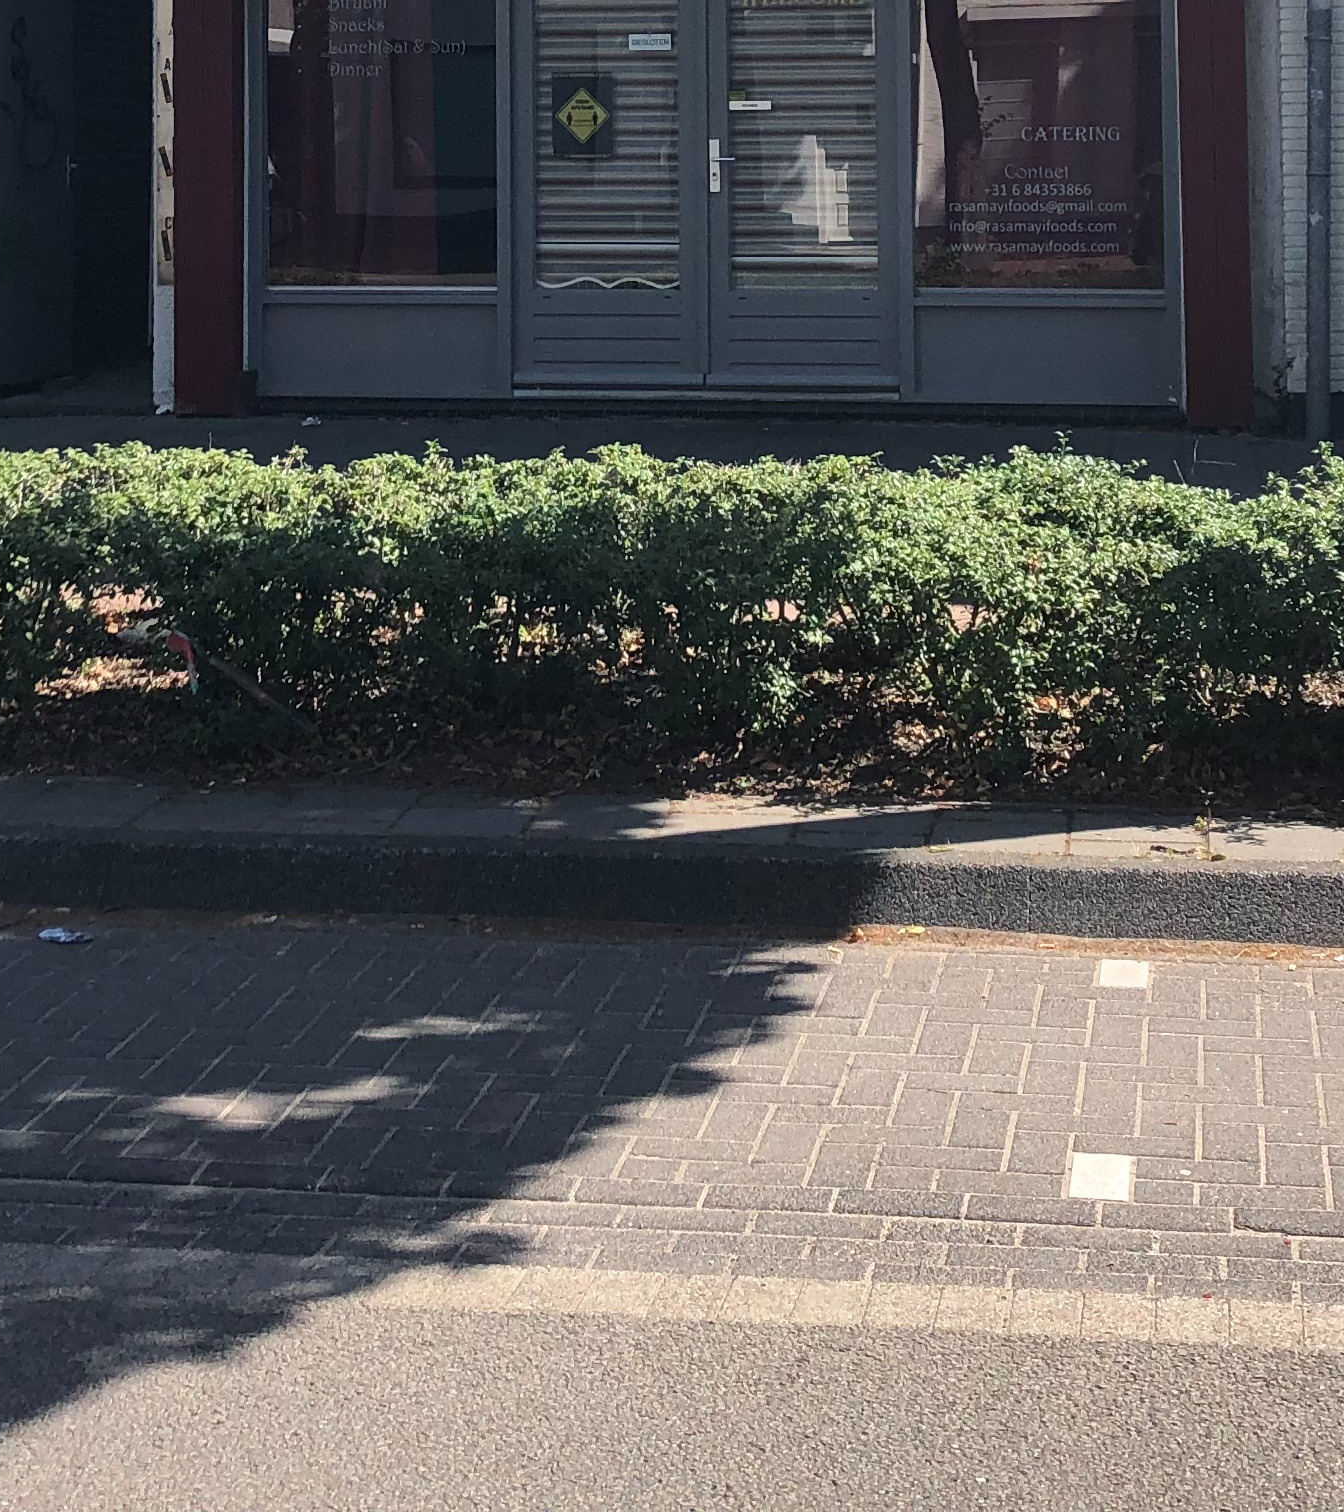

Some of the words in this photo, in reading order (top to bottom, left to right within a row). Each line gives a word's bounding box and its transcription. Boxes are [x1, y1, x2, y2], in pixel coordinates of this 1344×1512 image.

[328, 18, 385, 33] Snacks
[329, 62, 383, 77] Dinner
[1021, 126, 1121, 142] CATERING
[1004, 163, 1069, 179] Contact
[984, 184, 1007, 197] +31
[1012, 184, 1020, 196] 6
